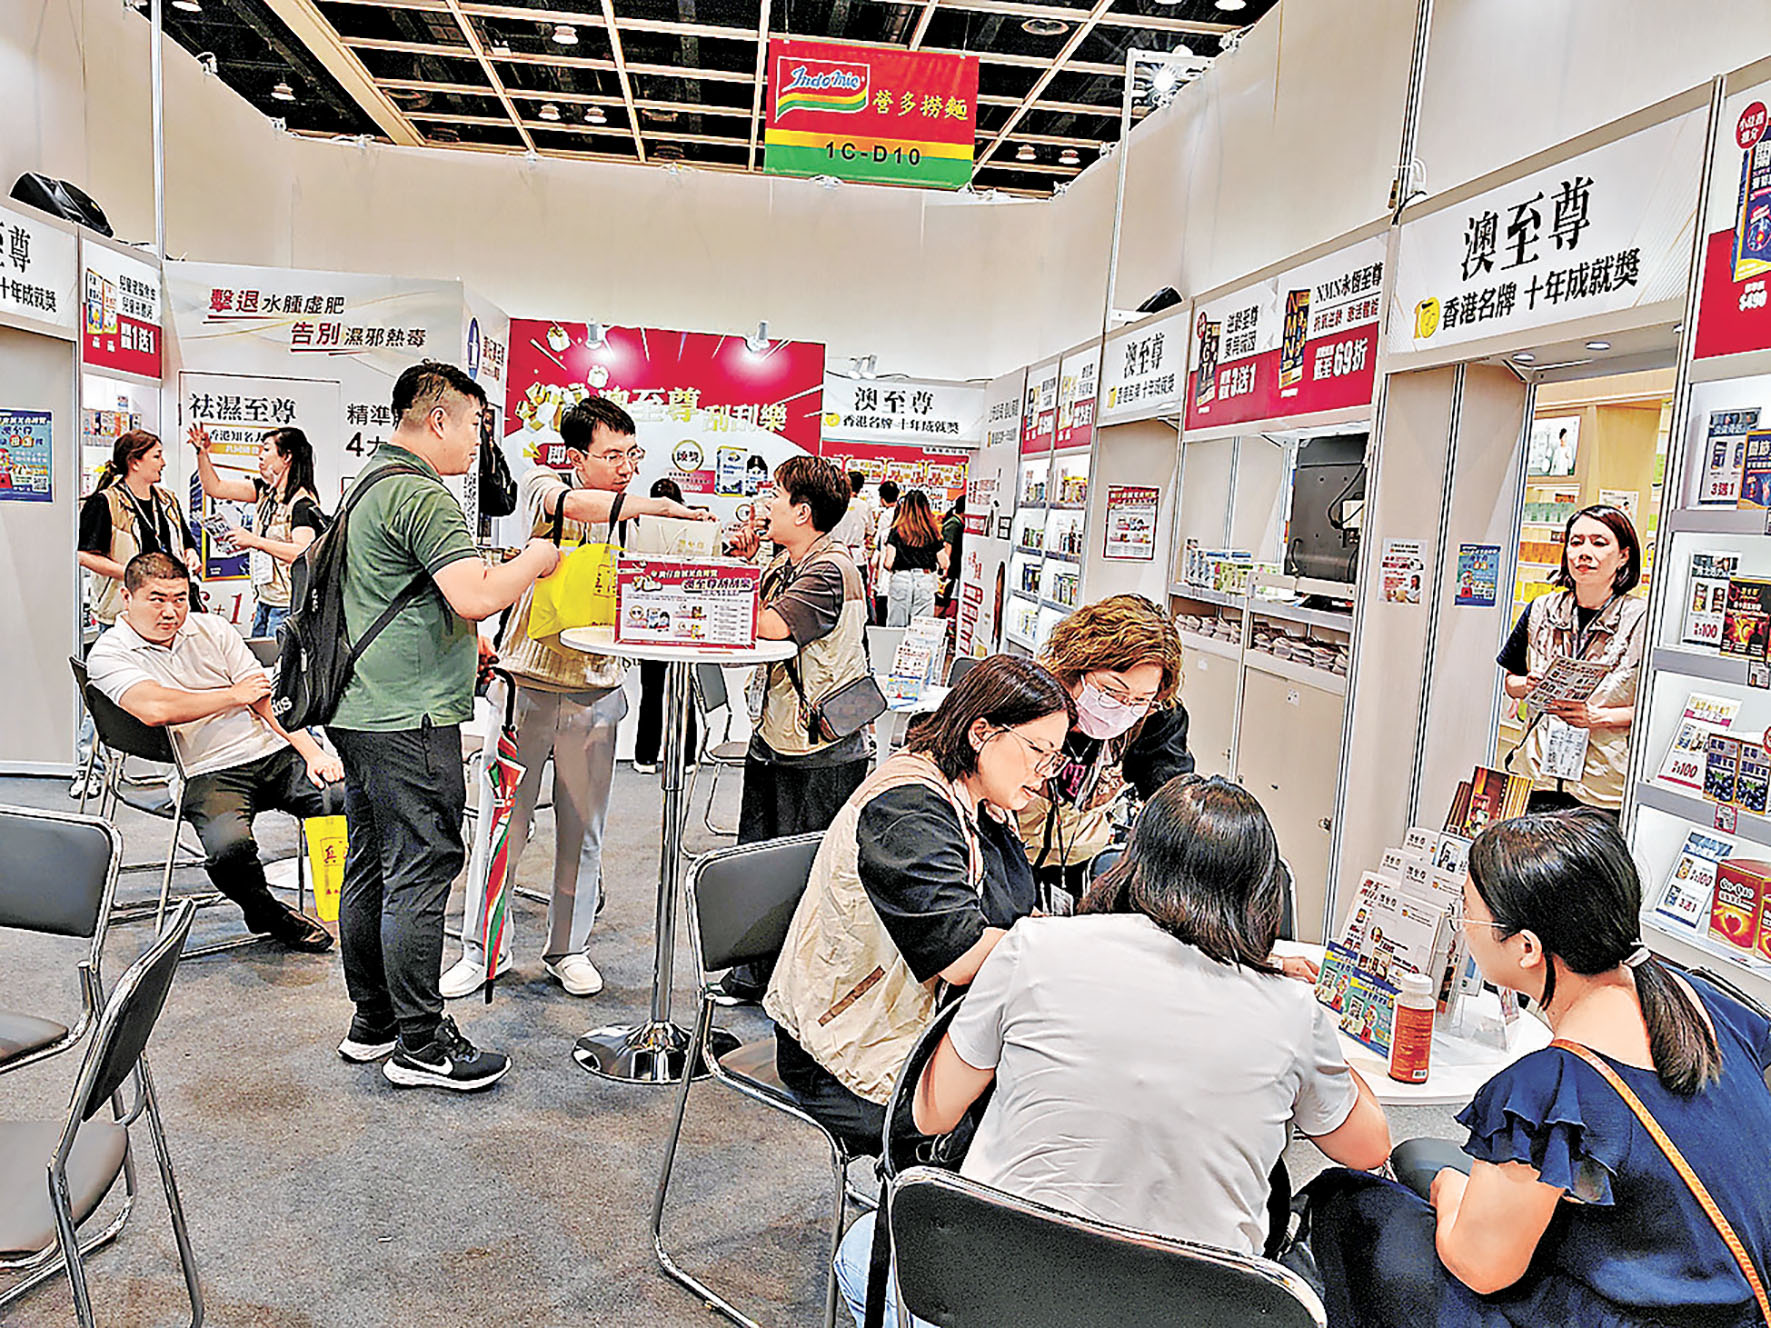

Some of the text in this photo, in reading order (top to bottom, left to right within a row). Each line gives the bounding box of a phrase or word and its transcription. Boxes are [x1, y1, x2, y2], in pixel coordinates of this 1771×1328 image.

[825, 141, 921, 165] 1C-D10
[1462, 176, 1595, 282] 澳至尊
[1442, 281, 1518, 331] 香港名牌
[1523, 248, 1641, 310] 十年成就獎
[188, 392, 297, 425] 祛濕至尊
[855, 387, 934, 415] 澳至尊
